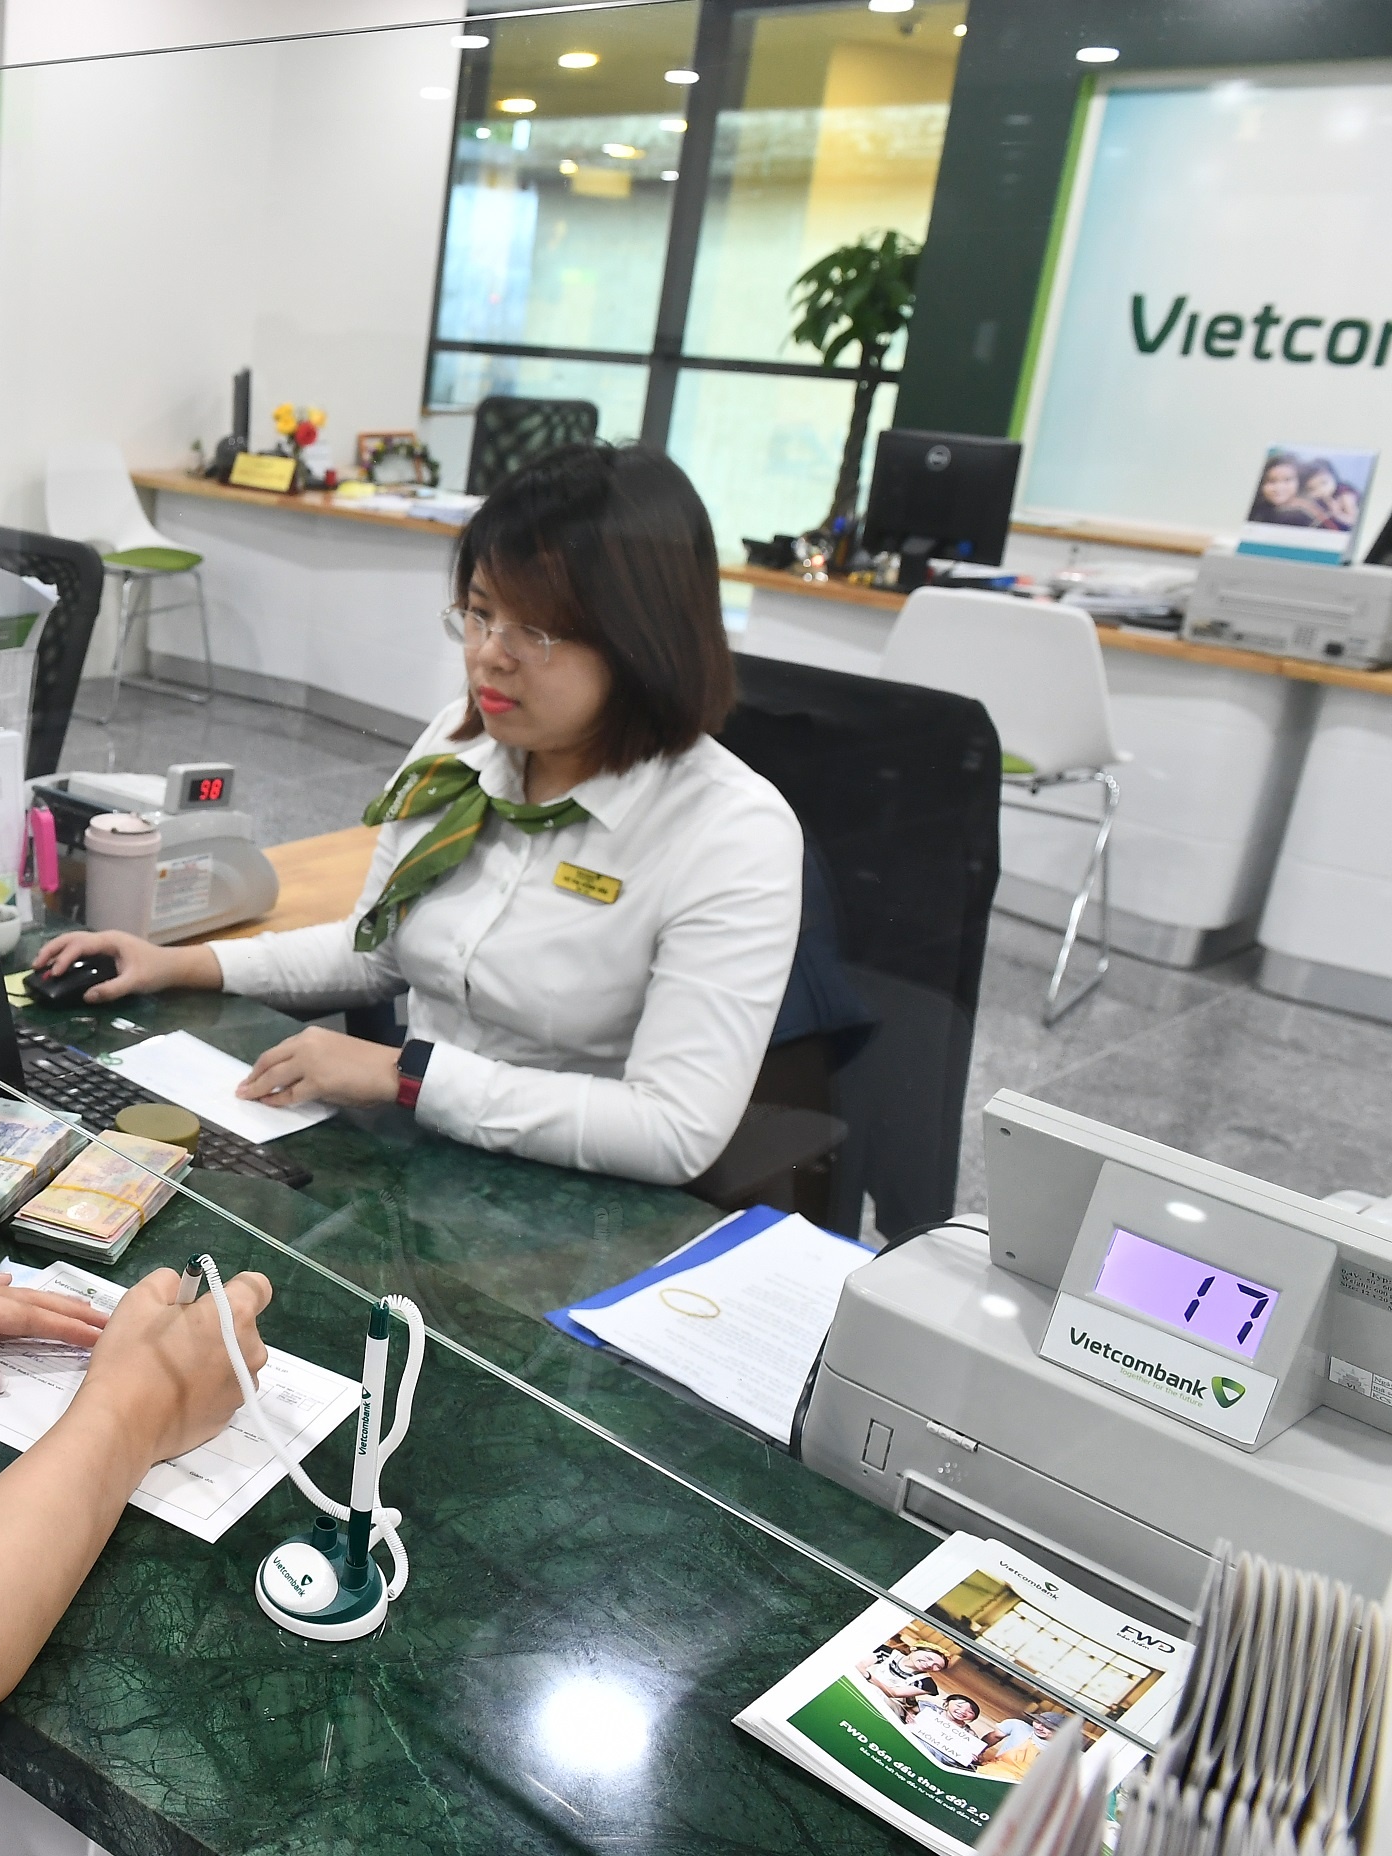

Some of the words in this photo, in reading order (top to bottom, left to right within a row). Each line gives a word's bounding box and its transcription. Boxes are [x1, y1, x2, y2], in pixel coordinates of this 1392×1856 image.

[199, 778, 225, 801] 98
[54, 1279, 96, 1301] Vietcombank
[1183, 1276, 1270, 1345] 17
[1070, 1327, 1208, 1400] Vietcombank
[1120, 1367, 1151, 1385] Together
[1152, 1381, 1164, 1391] for
[1165, 1387, 1178, 1396] the
[1179, 1392, 1203, 1408] future
[358, 1401, 372, 1456] Vietcombank
[273, 1556, 306, 1598] Vietcombank
[999, 1560, 1059, 1600] Vietcombank
[1120, 1625, 1176, 1654] FWD
[839, 1720, 869, 1744] FWD
[868, 1742, 893, 1763] Đón
[917, 1776, 945, 1796] thay
[966, 1806, 991, 1821] 2.0
[942, 1744, 962, 1758] NAY
